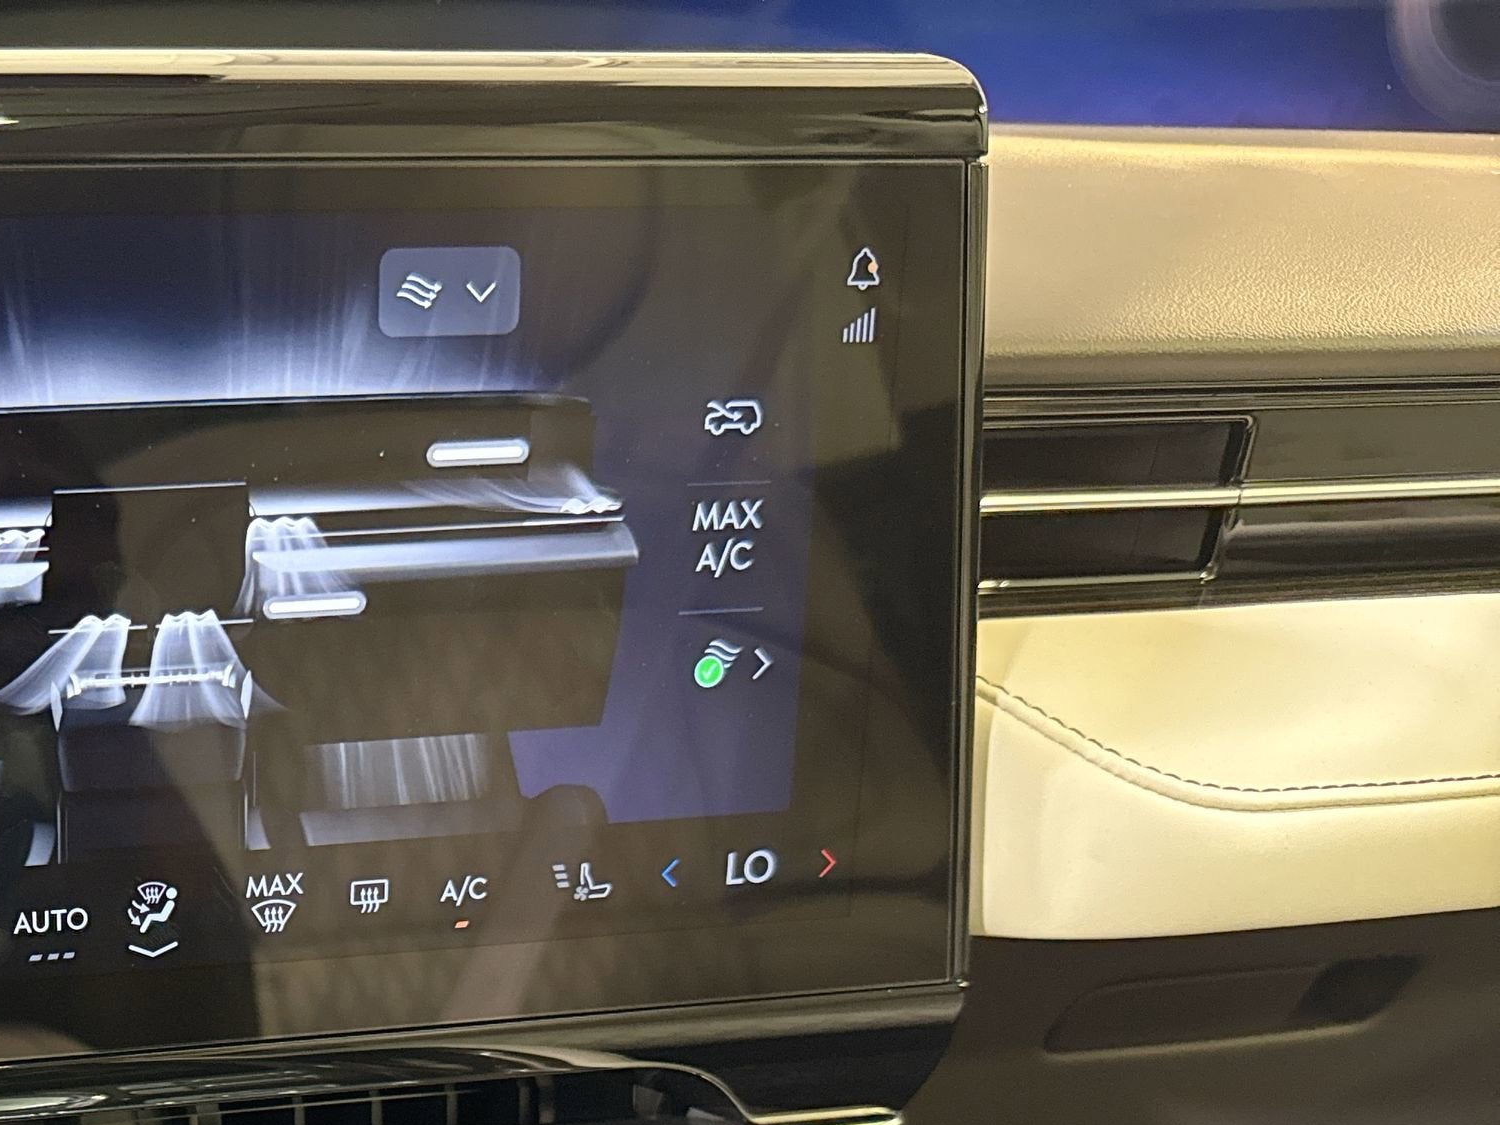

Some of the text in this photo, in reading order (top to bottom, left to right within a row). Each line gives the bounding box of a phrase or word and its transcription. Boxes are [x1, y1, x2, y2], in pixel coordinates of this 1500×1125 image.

[692, 499, 764, 532] MAX
[695, 538, 754, 578] A/C
[725, 849, 776, 886] LO
[246, 872, 304, 898] MAX
[440, 875, 488, 906] A/C
[13, 907, 89, 935] AUTO
